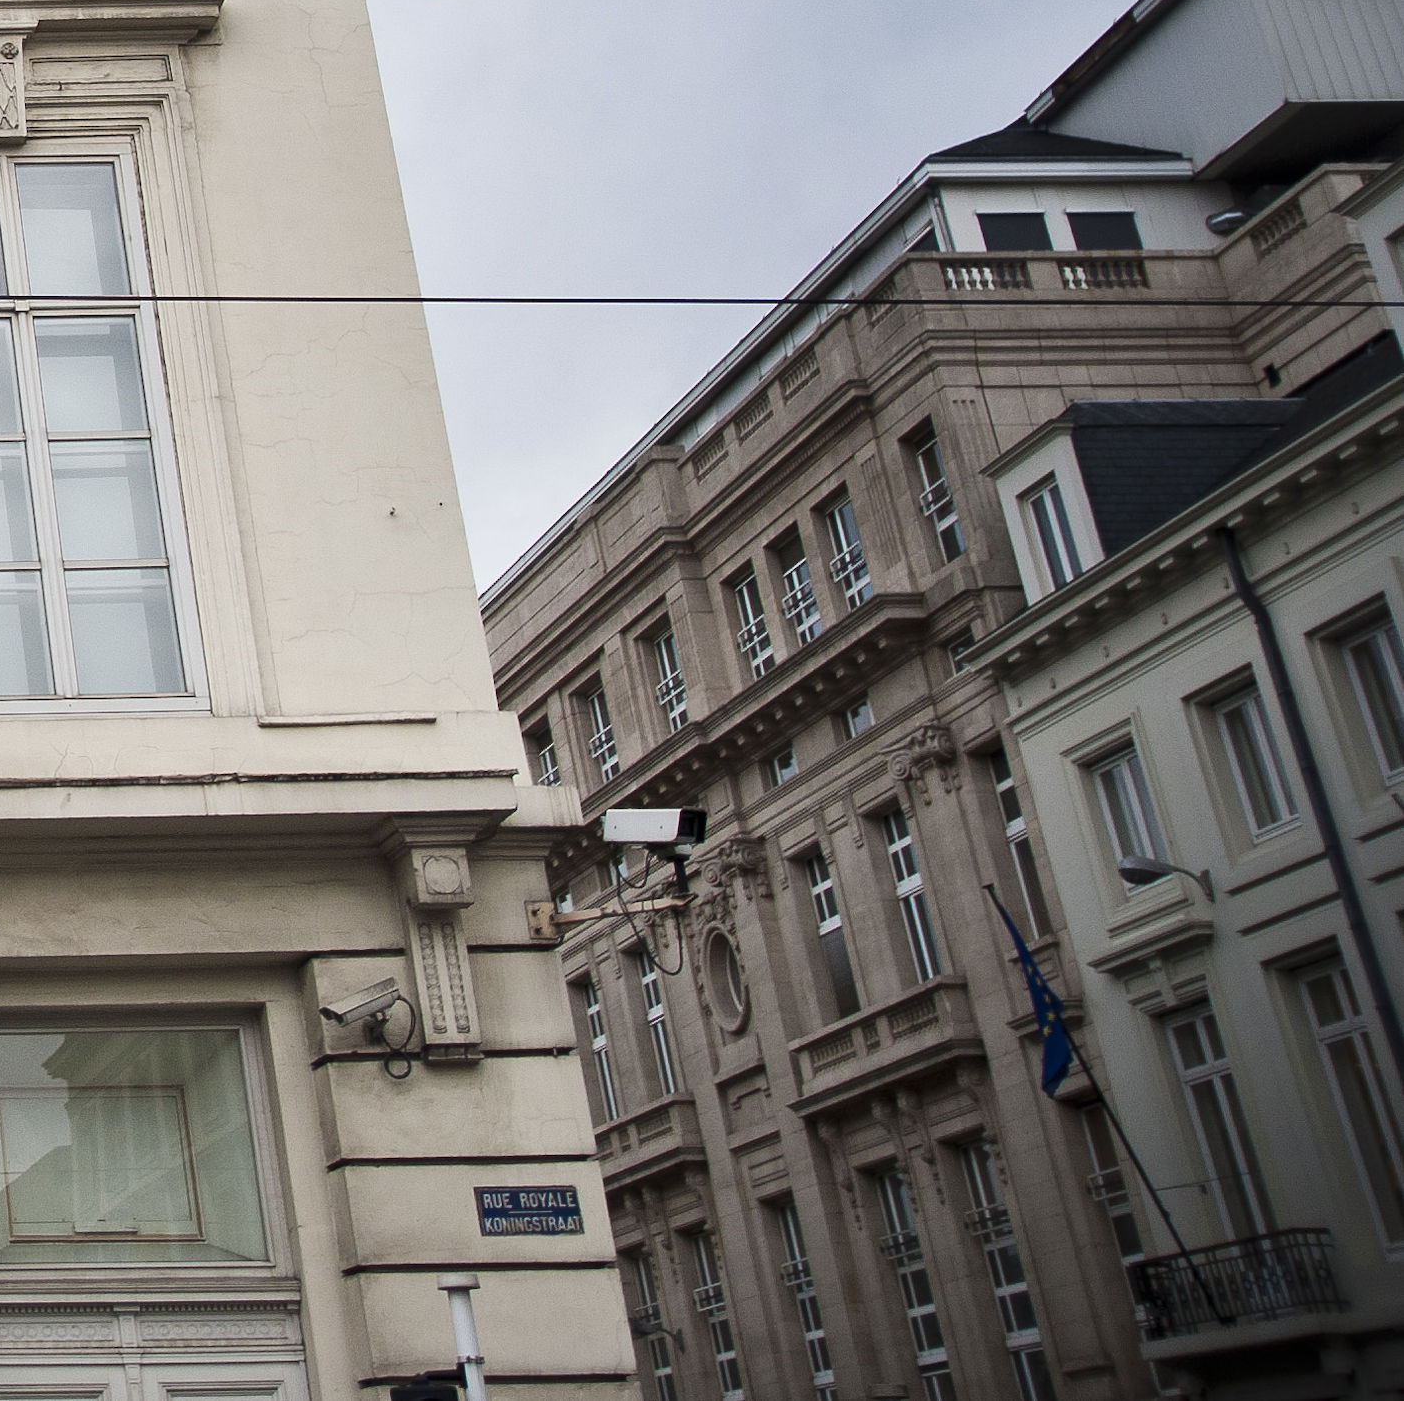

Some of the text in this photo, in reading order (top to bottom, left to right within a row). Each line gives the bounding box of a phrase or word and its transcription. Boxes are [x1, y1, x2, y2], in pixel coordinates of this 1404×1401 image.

[483, 1191, 577, 1208] RUE ROYALE
[484, 1215, 581, 1233] KONINGSTRAAT
